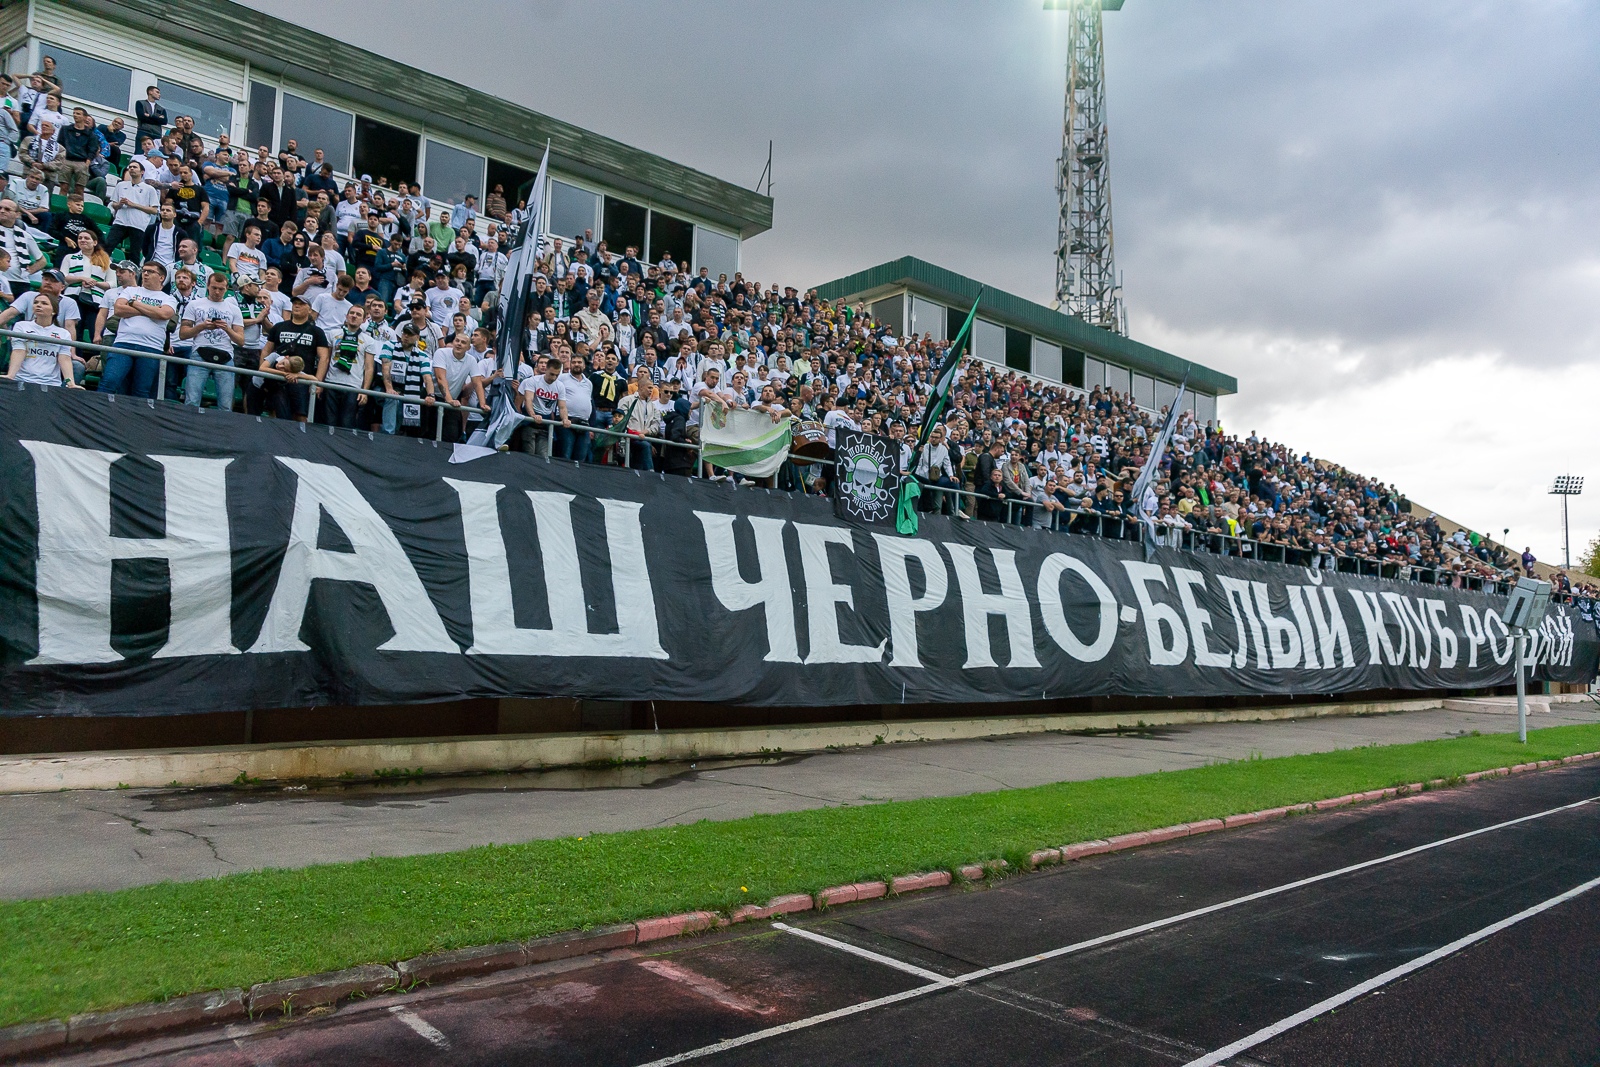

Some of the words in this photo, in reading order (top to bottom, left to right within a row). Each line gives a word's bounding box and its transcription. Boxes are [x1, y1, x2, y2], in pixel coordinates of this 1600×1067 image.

[19, 439, 670, 666] НАШ
[693, 510, 1356, 671] ЧЕРНО-БЕЛЫЙ
[1348, 588, 1458, 671] КЛУБ
[851, 496, 883, 512] МОСКВА
